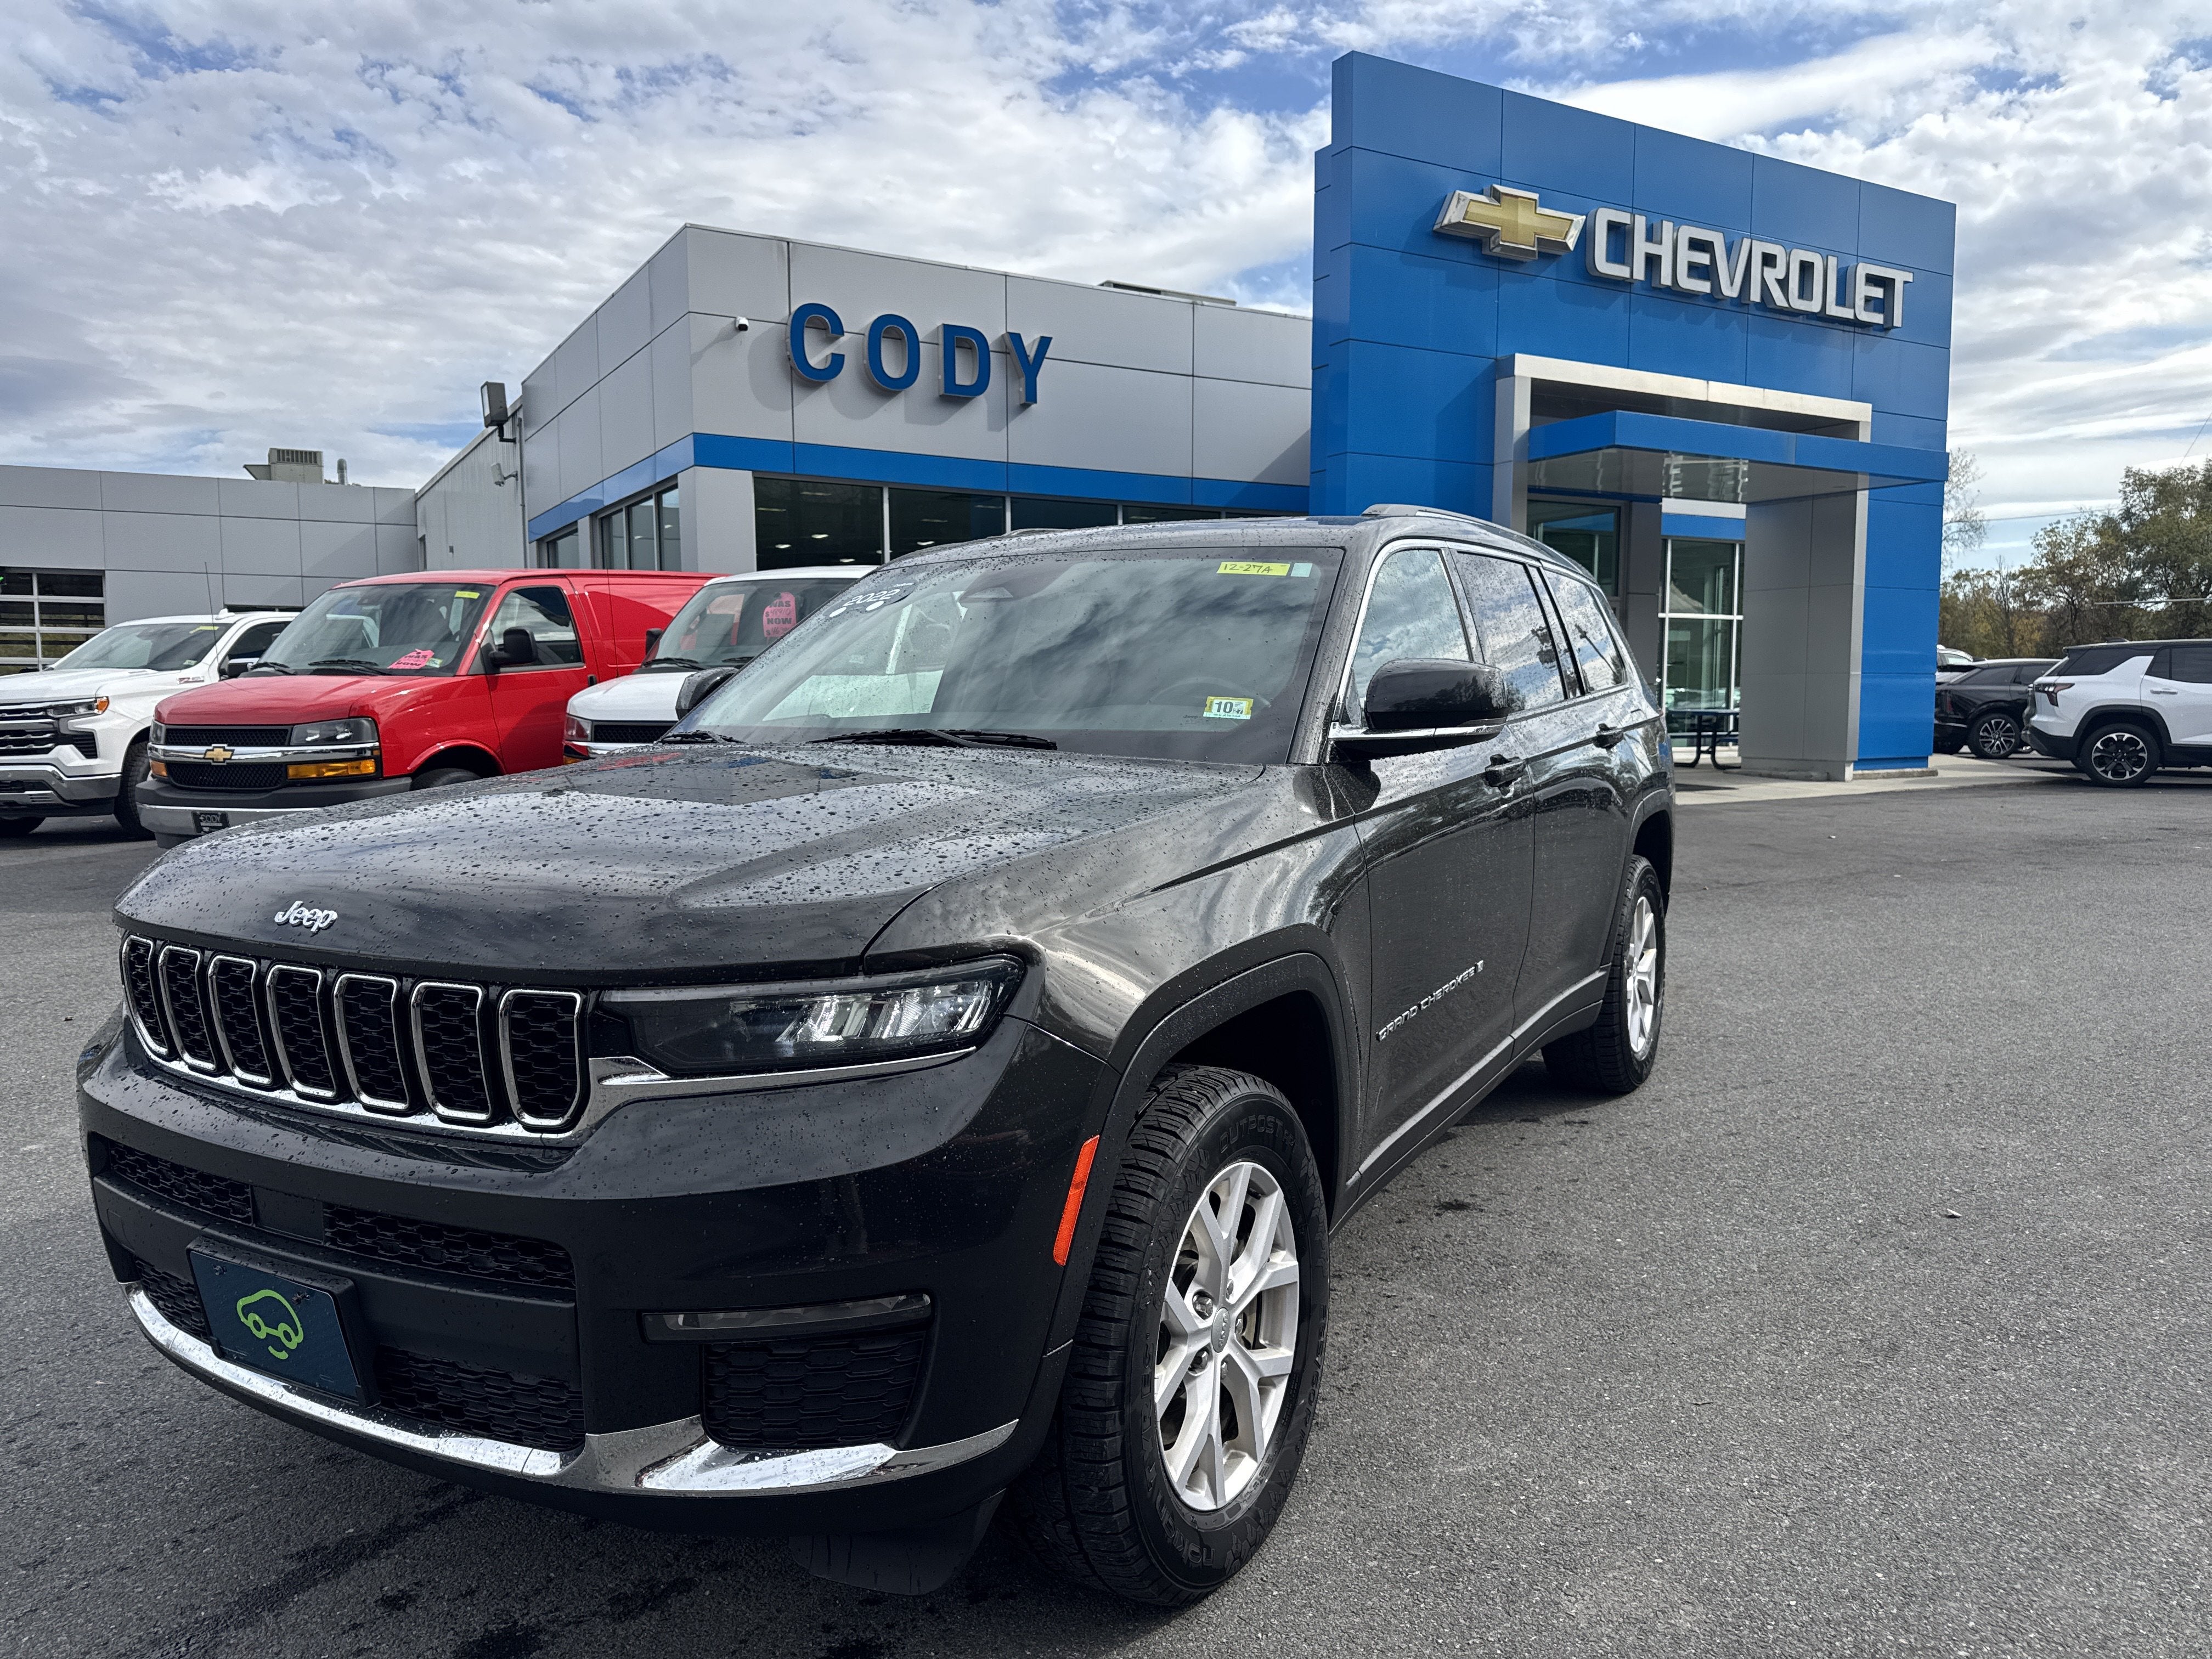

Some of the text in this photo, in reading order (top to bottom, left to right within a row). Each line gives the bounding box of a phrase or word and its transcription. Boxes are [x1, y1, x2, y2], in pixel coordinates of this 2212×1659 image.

[1586, 207, 1914, 329] CHEVROLET
[787, 303, 1053, 405] CODY
[1223, 563, 1272, 574] 12-27A
[842, 589, 900, 607] 2022
[1215, 701, 1233, 714] 10
[274, 900, 338, 933] Jeep
[1378, 1005, 1418, 1041] GRAND
[1420, 966, 1476, 1011] CHEROKEE
[1220, 1114, 1284, 1154] OUTPOST
